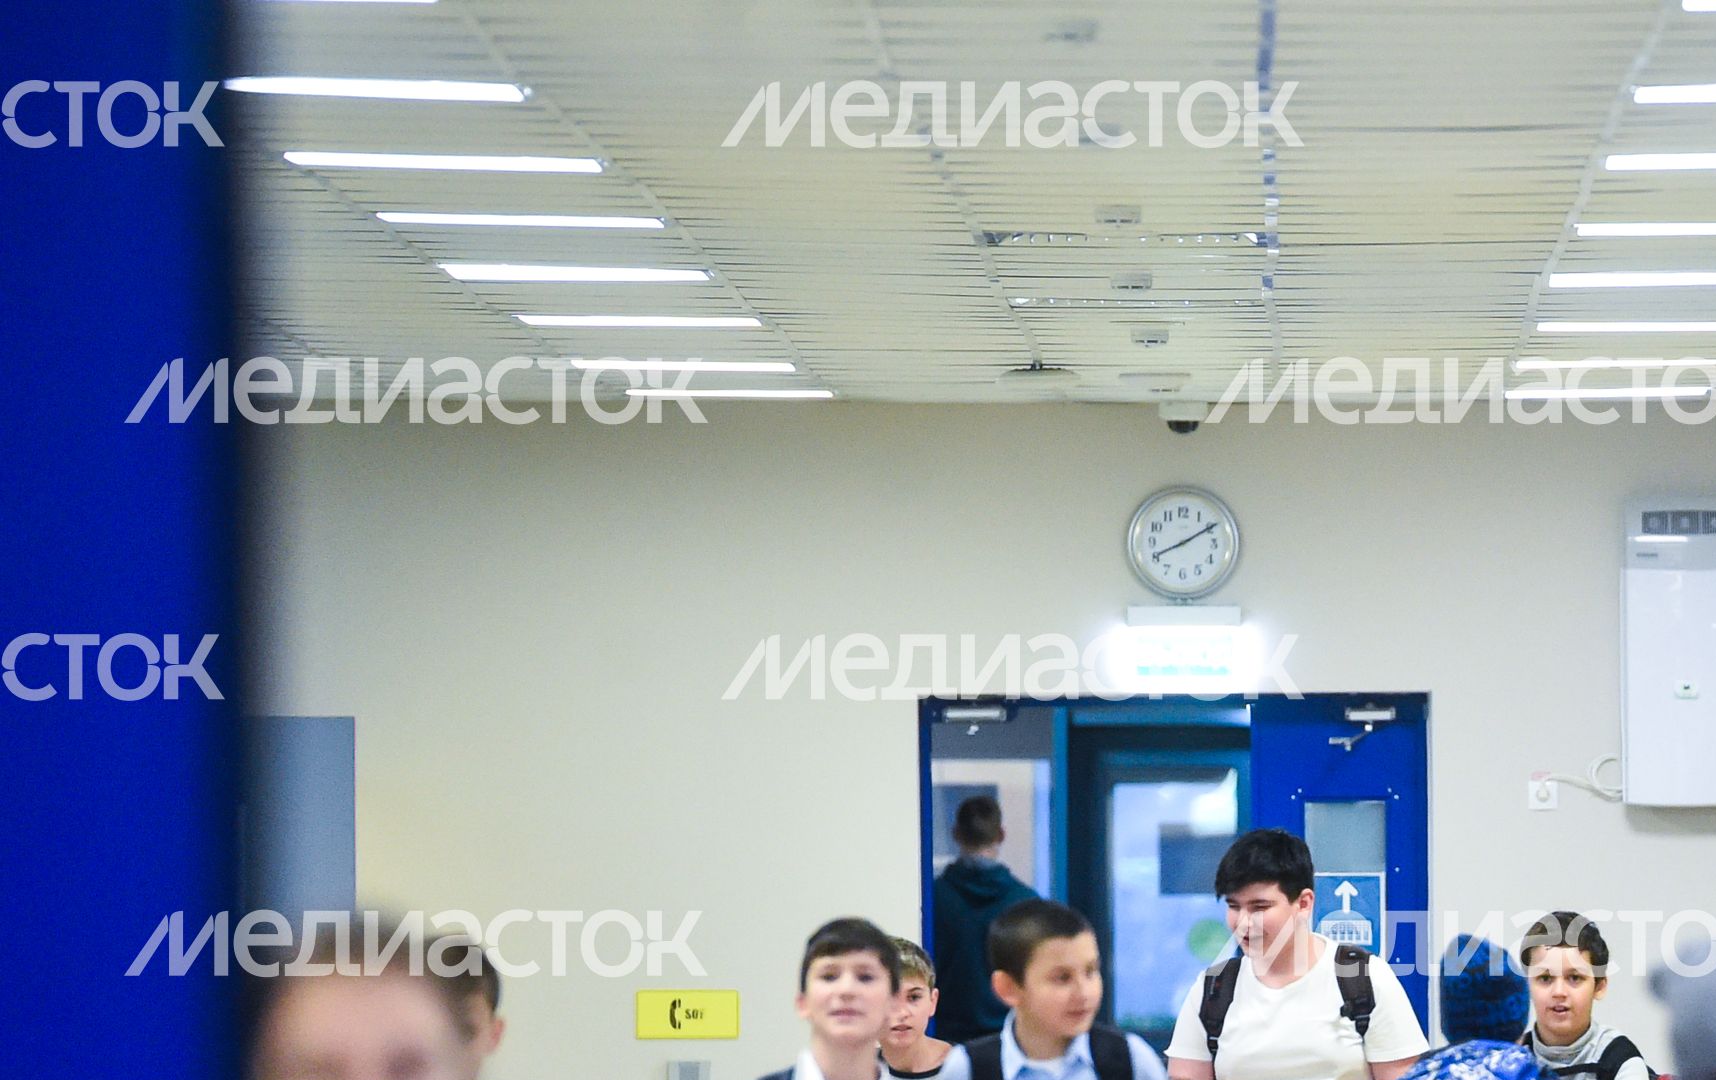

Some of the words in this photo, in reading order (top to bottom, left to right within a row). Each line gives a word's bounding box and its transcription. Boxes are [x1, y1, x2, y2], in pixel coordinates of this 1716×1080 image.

[1164, 510, 1172, 522] 11
[1178, 506, 1189, 518] 12
[1151, 521, 1162, 533] 10
[1148, 536, 1156, 548] 9
[1210, 538, 1218, 549] 3
[1152, 551, 1160, 563] 8
[1205, 553, 1214, 564] 4
[1163, 563, 1171, 576] 7
[1179, 568, 1187, 580] 6
[1194, 564, 1202, 576] 5
